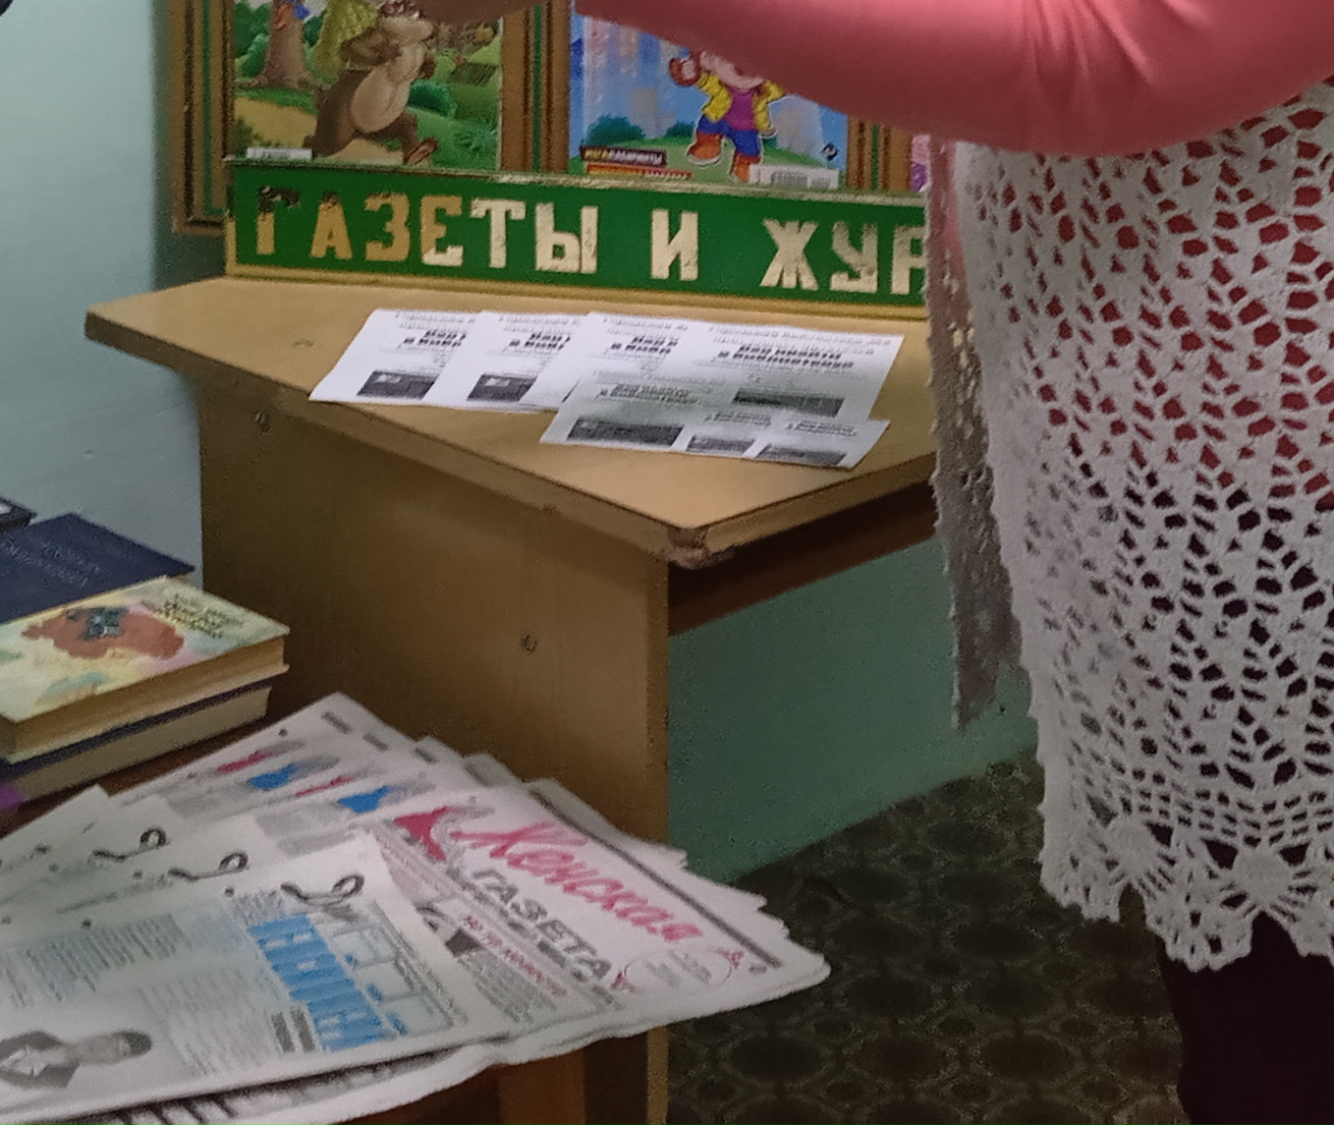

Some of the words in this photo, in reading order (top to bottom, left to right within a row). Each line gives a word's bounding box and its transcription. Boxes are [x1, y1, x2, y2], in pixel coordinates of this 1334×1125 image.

[257, 186, 598, 274] ГАЗЕТЫ
[651, 209, 699, 281] И
[760, 219, 926, 295] ЖУР
[449, 820, 703, 942] Женская
[470, 869, 613, 979] ГАЗЕТА
